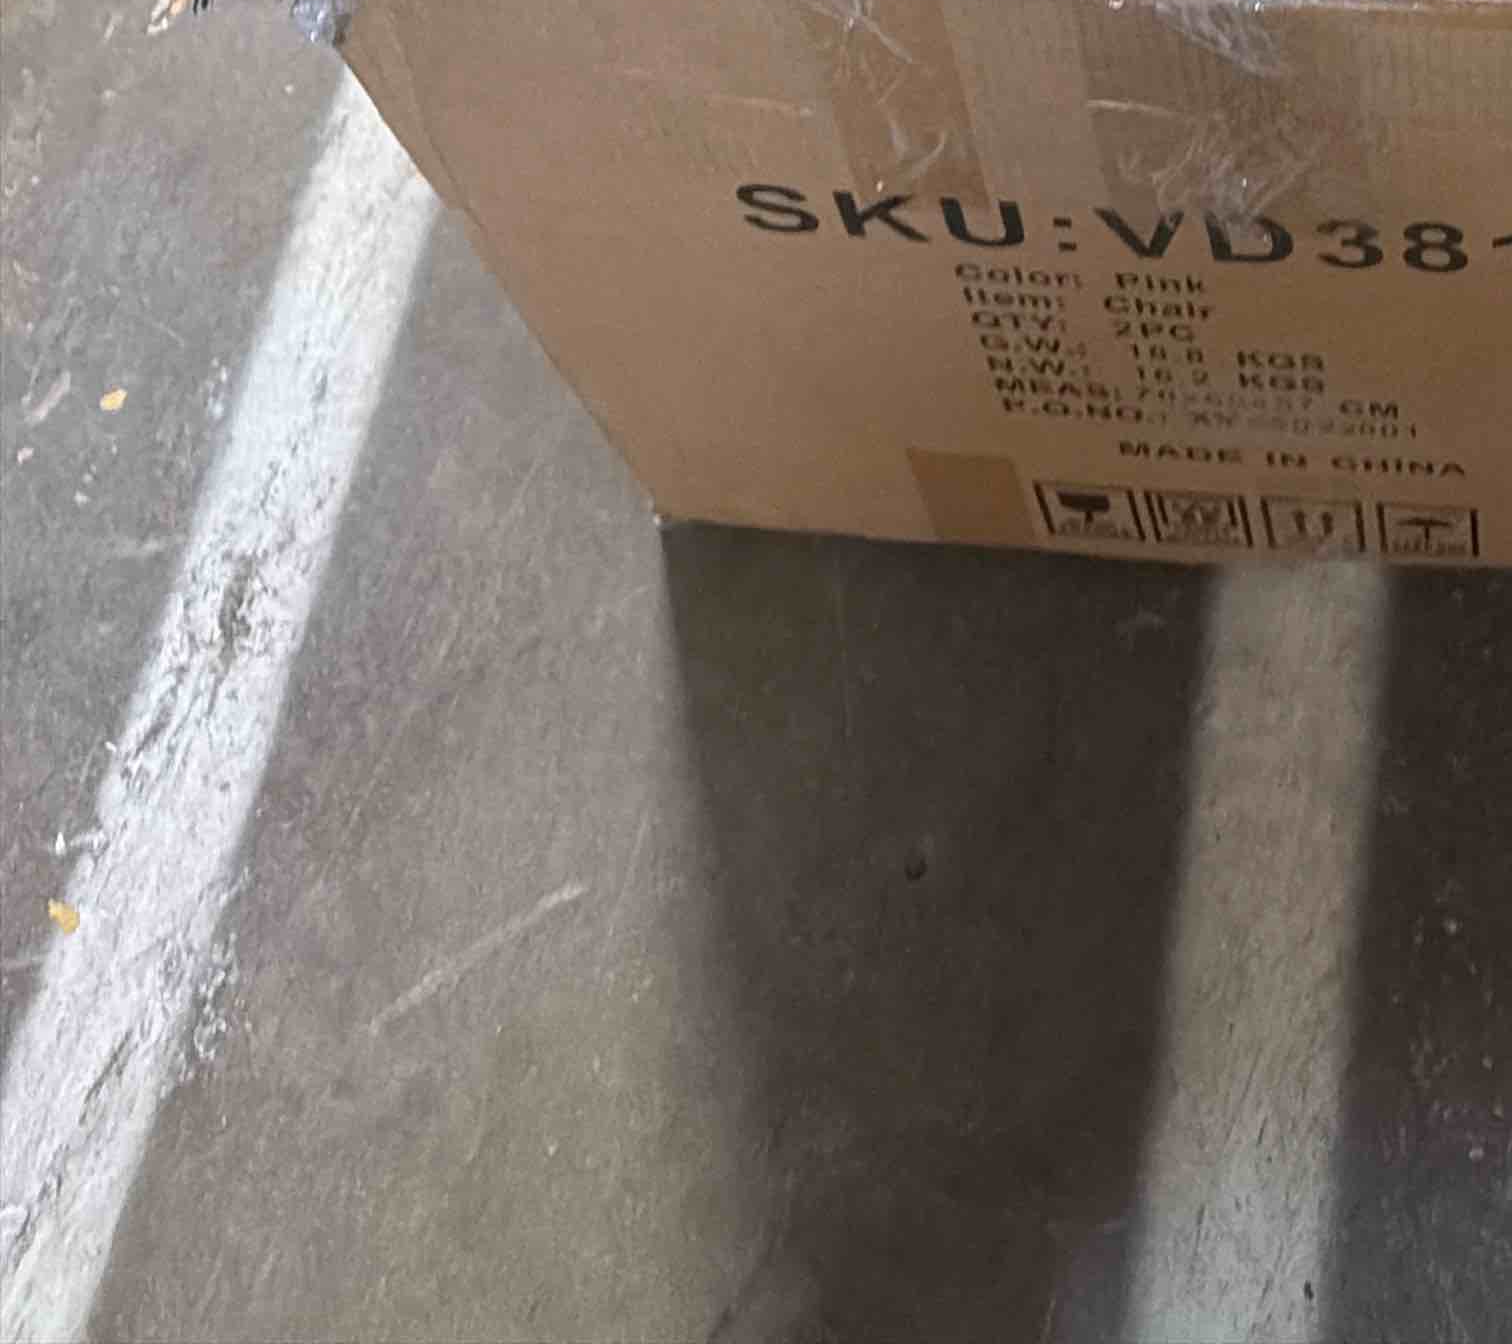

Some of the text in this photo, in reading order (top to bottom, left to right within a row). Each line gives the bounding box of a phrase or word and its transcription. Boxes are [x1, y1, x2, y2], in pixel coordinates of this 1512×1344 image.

[1115, 272, 1207, 294] Pink
[1104, 296, 1217, 320] Chair
[1118, 441, 1467, 478] MADE IN CHINA
